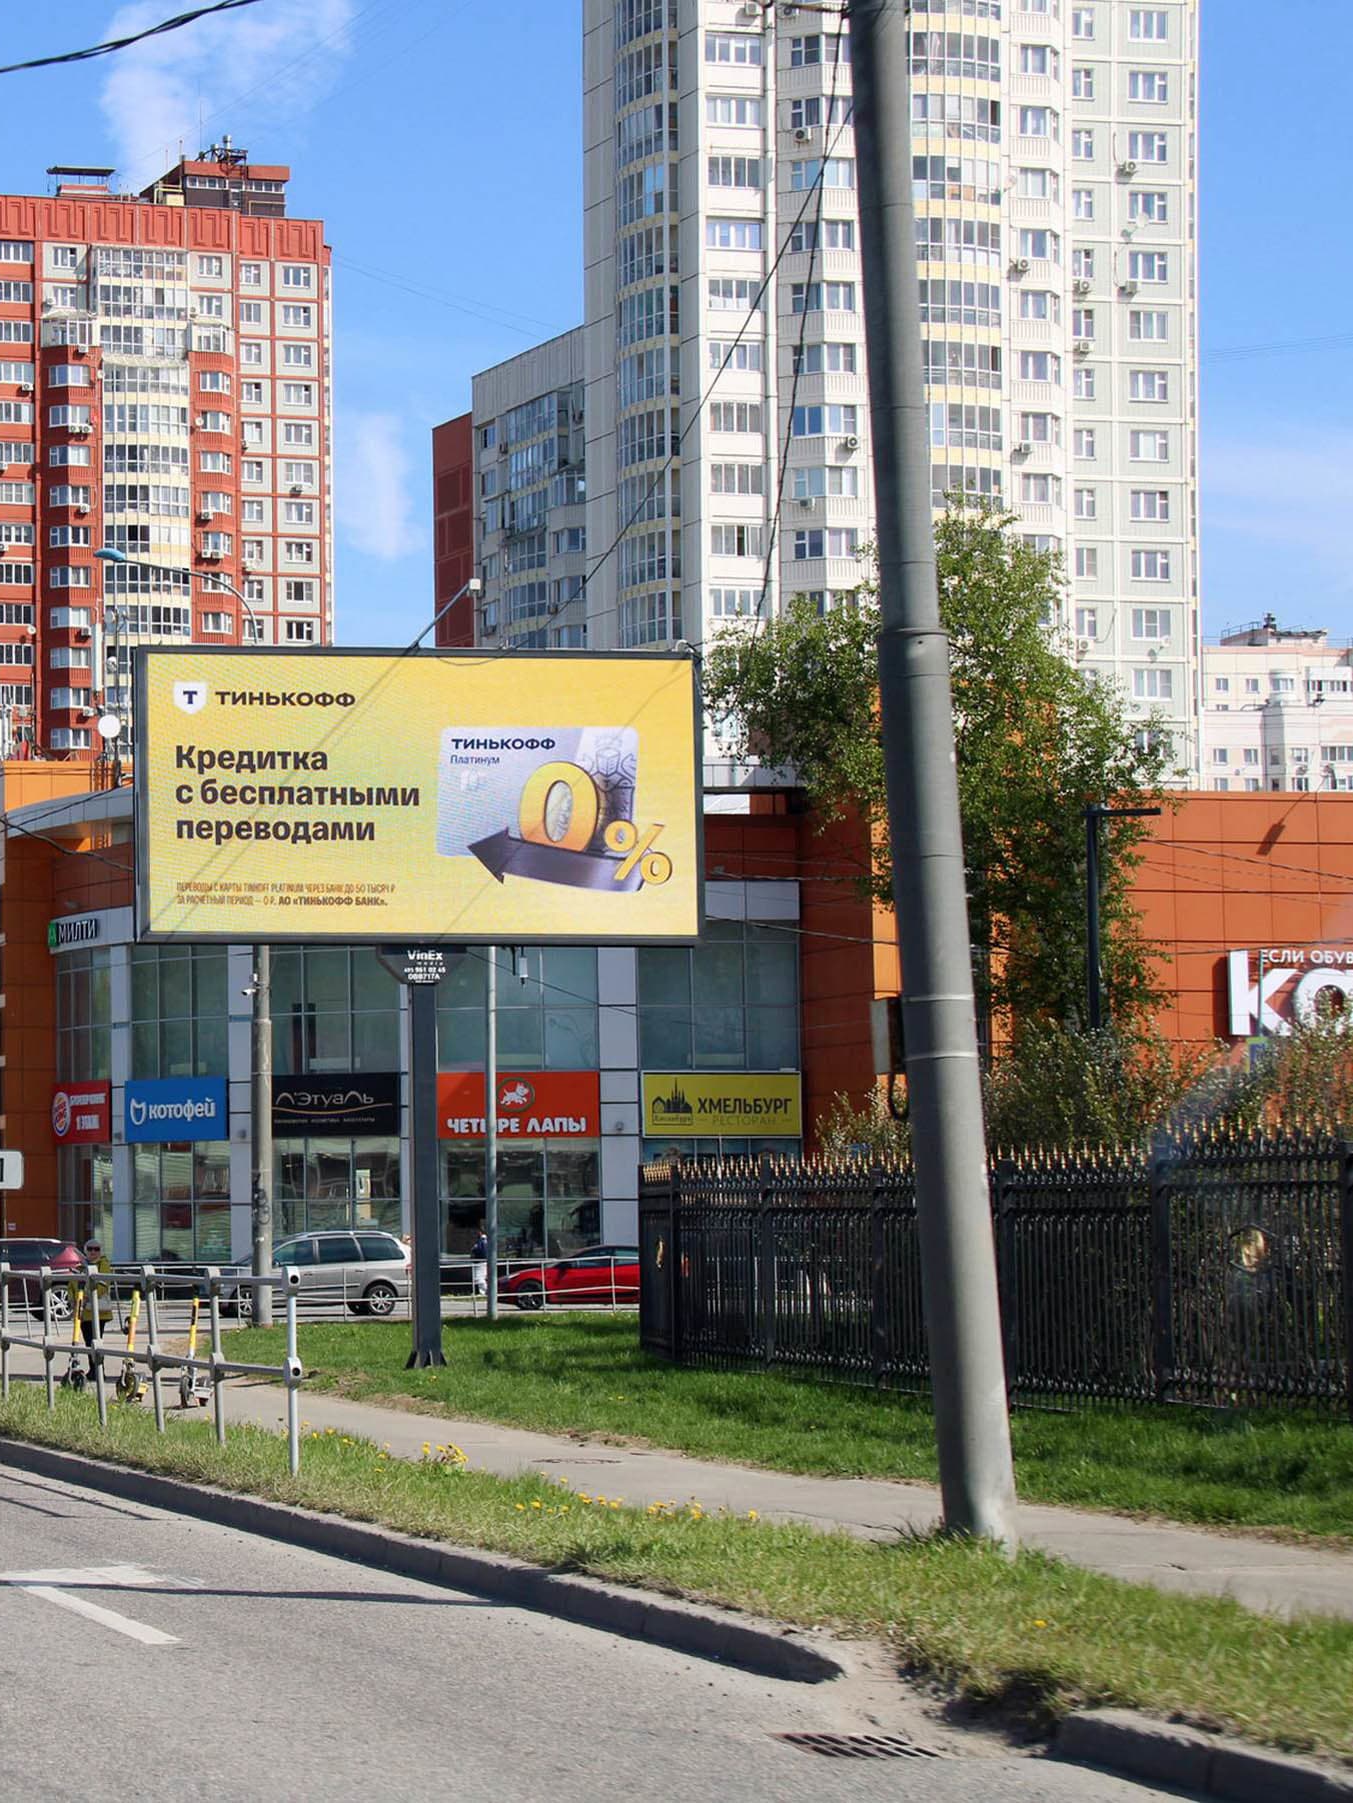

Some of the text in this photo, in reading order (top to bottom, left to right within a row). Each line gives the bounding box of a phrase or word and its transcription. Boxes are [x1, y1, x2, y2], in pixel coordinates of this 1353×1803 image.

[215, 691, 356, 707] ТИНЬКОФФ
[451, 738, 556, 750] ТИНЬКОФФ
[175, 745, 328, 774] Кредитка
[450, 754, 500, 766] Платинум
[175, 778, 420, 806] с бесплатными
[176, 818, 376, 845] переводами
[278, 896, 291, 905] АО
[58, 919, 96, 944] МИЛТИ
[407, 949, 444, 960] VinEx
[1259, 949, 1305, 963] ЕСЛИ
[697, 1097, 793, 1114] ХМЕЛЬБУРГ
[527, 1117, 587, 1133] ЛАПЫ
[712, 1116, 777, 1126] РЕСТОРАН
